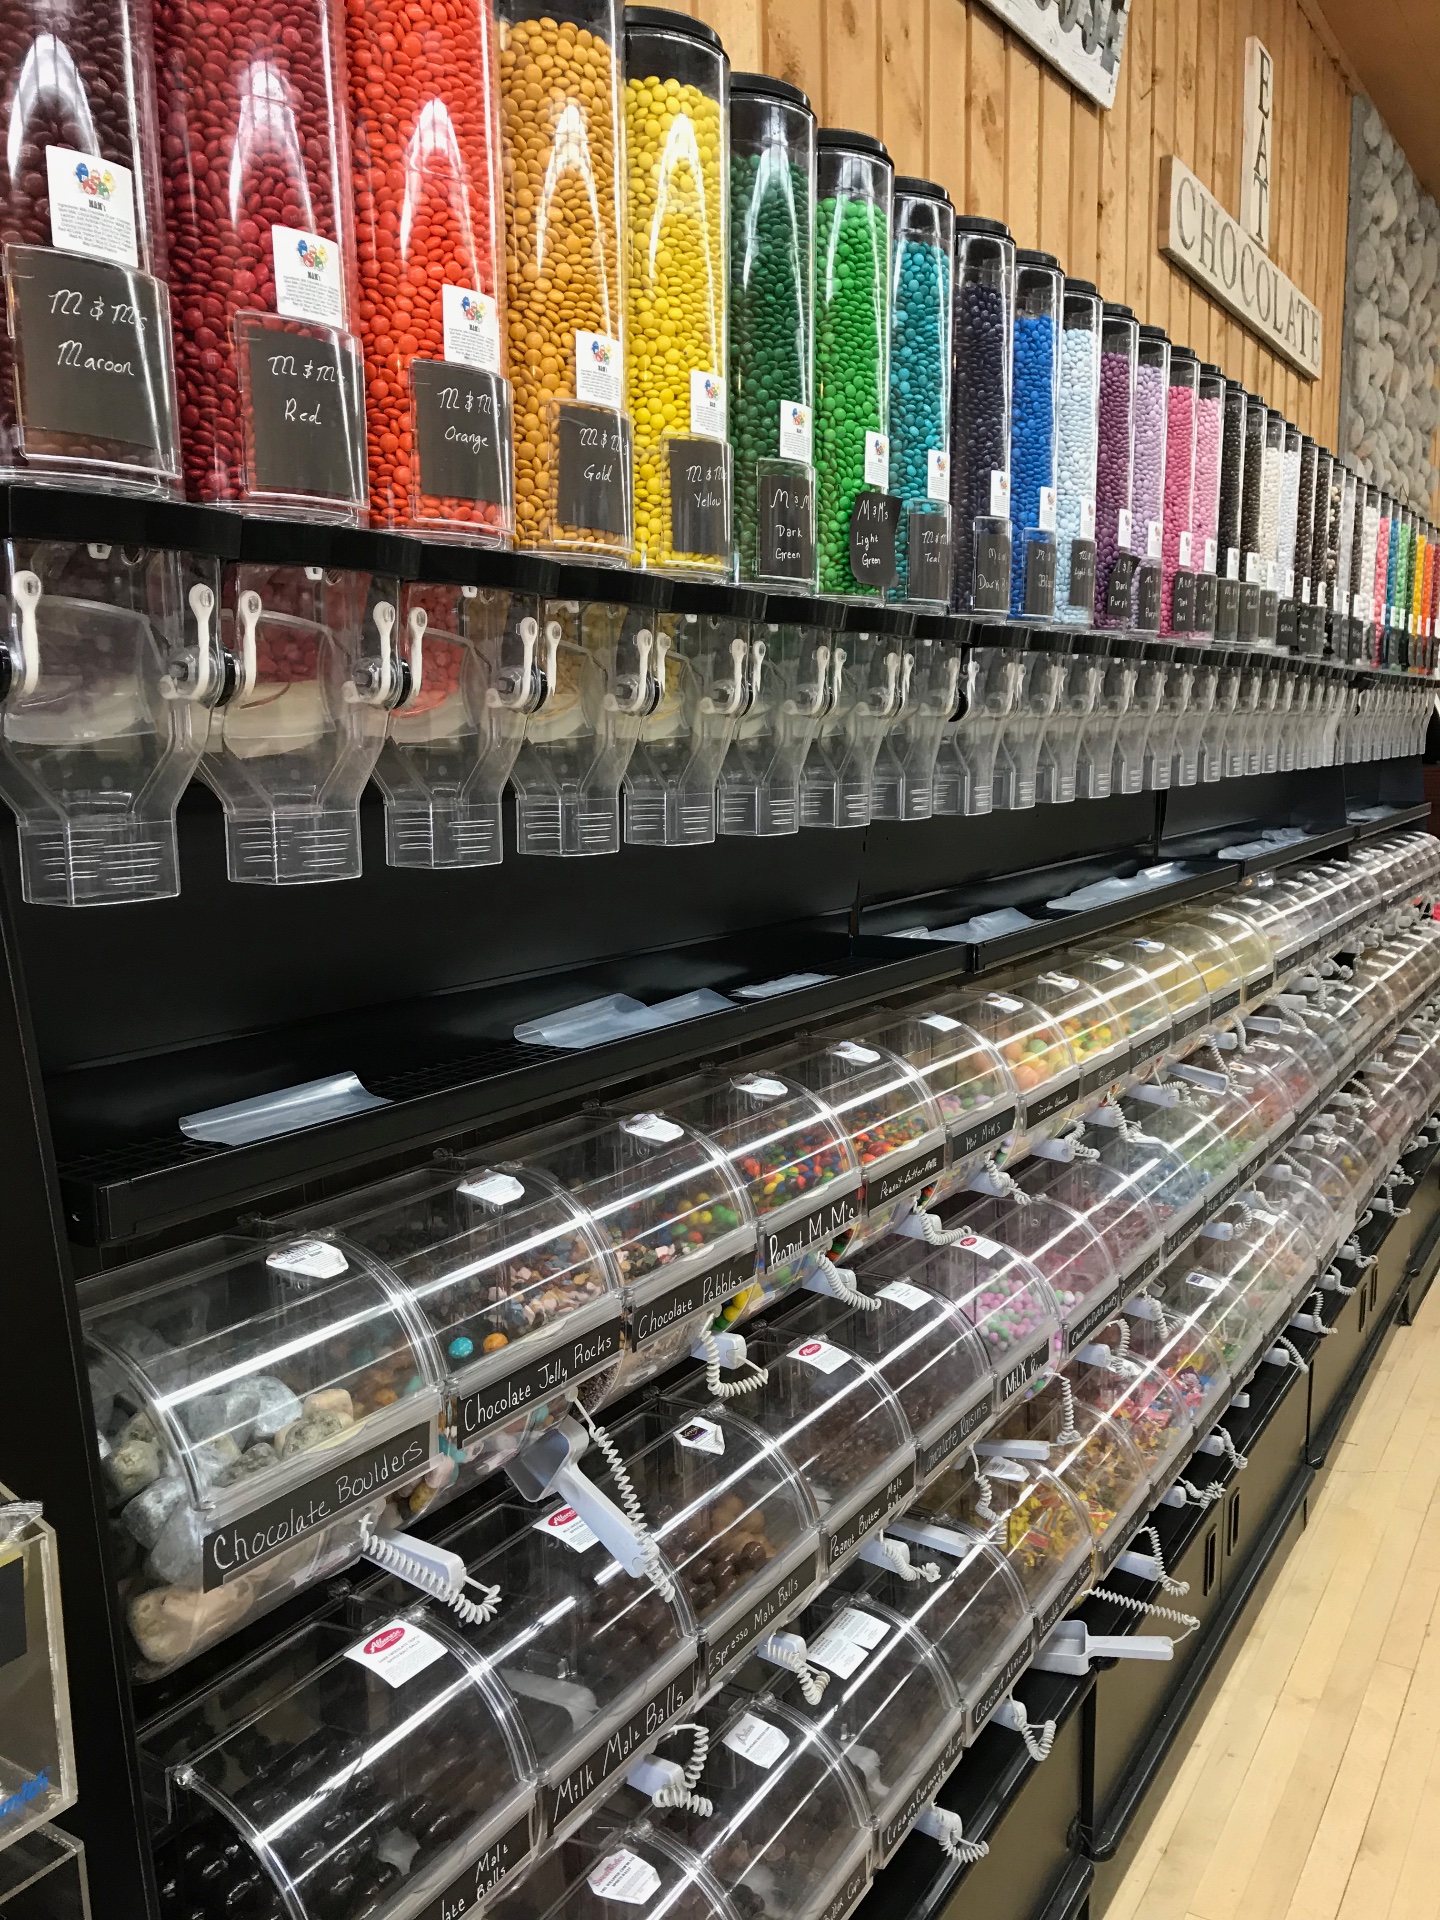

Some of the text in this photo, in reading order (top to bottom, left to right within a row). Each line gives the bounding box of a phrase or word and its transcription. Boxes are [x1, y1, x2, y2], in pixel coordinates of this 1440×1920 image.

[1253, 46, 1271, 243] EAT
[1176, 177, 1322, 366] CHOCOLATE
[48, 289, 82, 315] M
[57, 340, 135, 376] Maroon
[267, 355, 298, 376] M
[284, 397, 322, 425] Red
[437, 387, 460, 409] M
[444, 425, 489, 455] Orange
[580, 427, 598, 446] M
[583, 463, 613, 483] Gold
[685, 465, 703, 483] M
[693, 491, 722, 508] Yellow
[775, 524, 803, 538] Dark
[856, 531, 879, 552] Light
[775, 547, 801, 562] Green
[861, 553, 881, 568] Green
[924, 551, 941, 563] Teal
[769, 1231, 804, 1266] Peanut
[637, 1271, 744, 1340] Chocolate Pebbles
[463, 1336, 613, 1432] Chocolate Jelly Rocks
[960, 1402, 989, 1438] Raisins
[886, 1477, 903, 1500] Malt
[212, 1440, 424, 1571] Chocolate Boulders
[829, 1507, 880, 1562] Peanut Butter
[707, 1577, 800, 1676] Espresso Malt Balls
[975, 1676, 1005, 1724] Coconut
[552, 1764, 594, 1824] Milk
[602, 1730, 641, 1777] Malt
[645, 1683, 684, 1736] Balls
[886, 1801, 916, 1845] Cream
[475, 1843, 509, 1884] Malt
[476, 1866, 506, 1901] Balls
